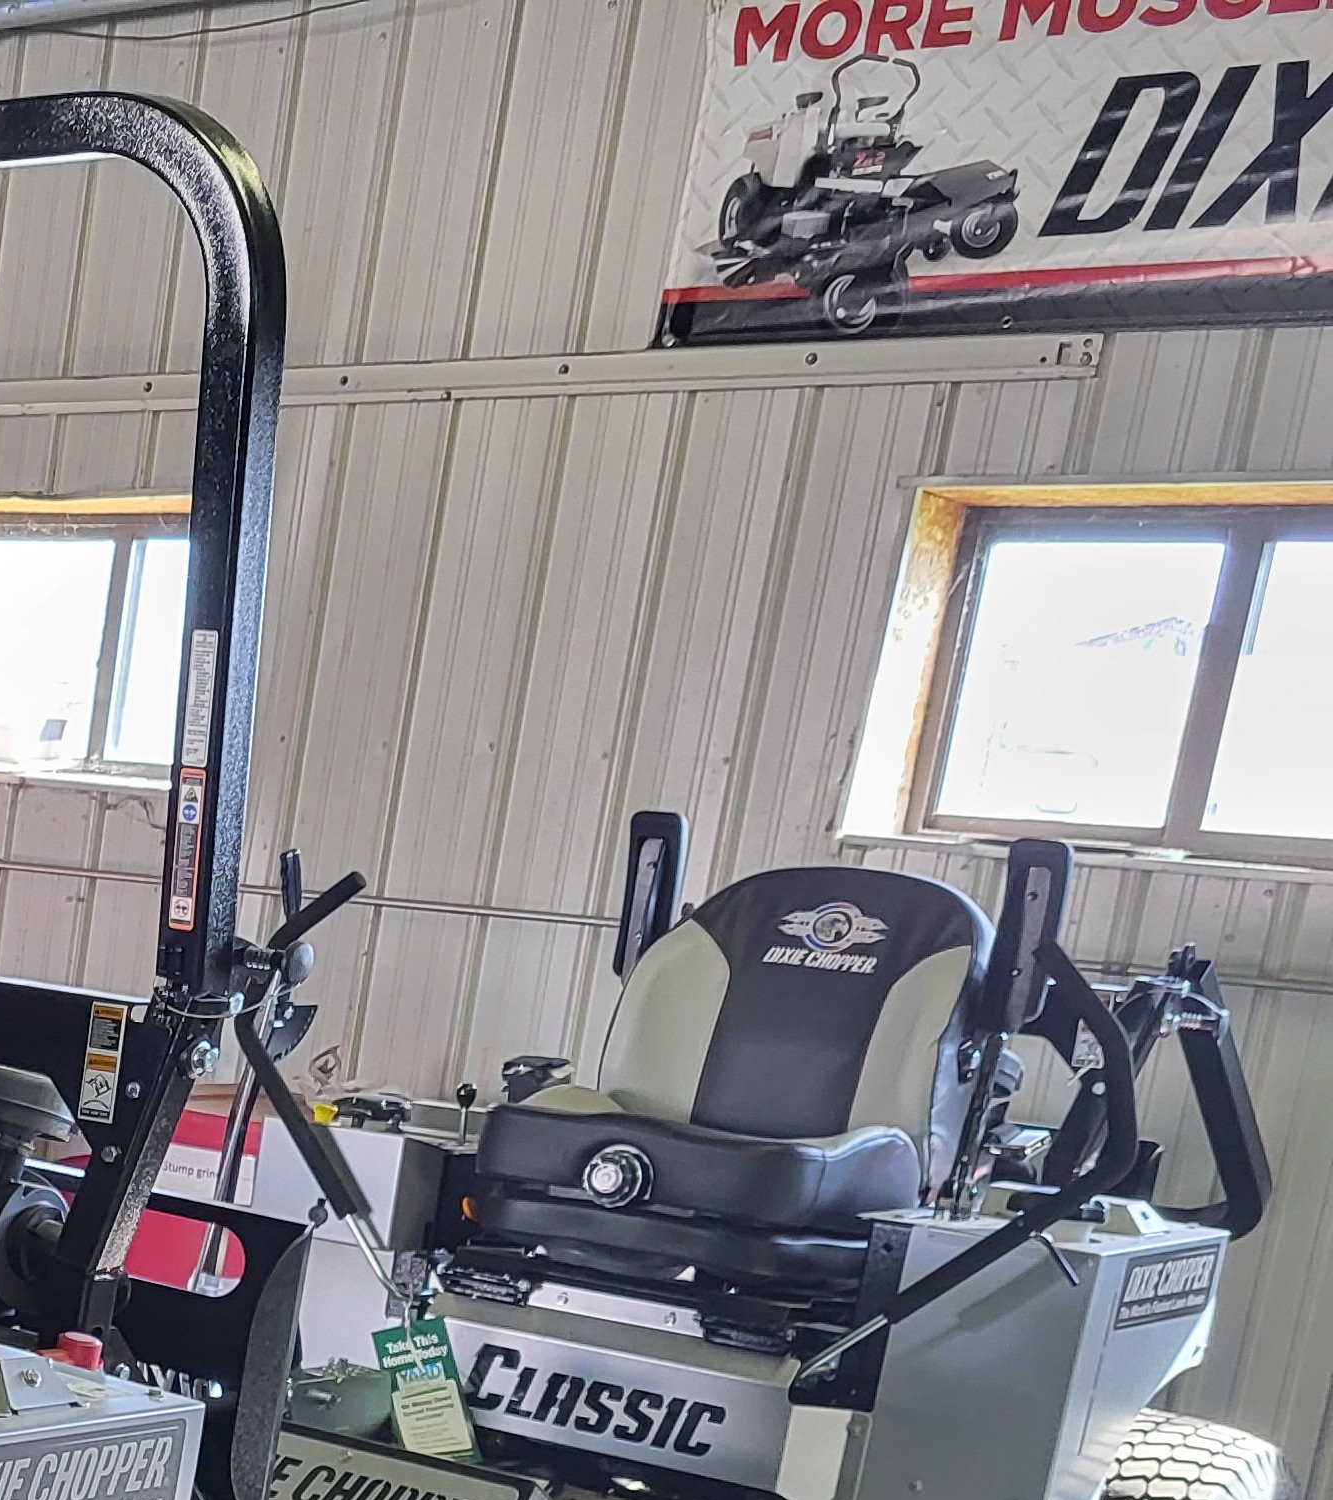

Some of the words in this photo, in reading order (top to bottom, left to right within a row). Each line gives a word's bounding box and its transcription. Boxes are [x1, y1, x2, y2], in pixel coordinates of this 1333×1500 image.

[734, 0, 974, 66] MORE
[1037, 60, 1333, 238] DIX
[763, 944, 809, 966] DIXIE
[804, 950, 879, 975] CHOPPER
[163, 1162, 194, 1176] Stump
[197, 1168, 220, 1180] grin
[413, 1333, 439, 1348] This
[463, 1343, 726, 1457] CLASSIC
